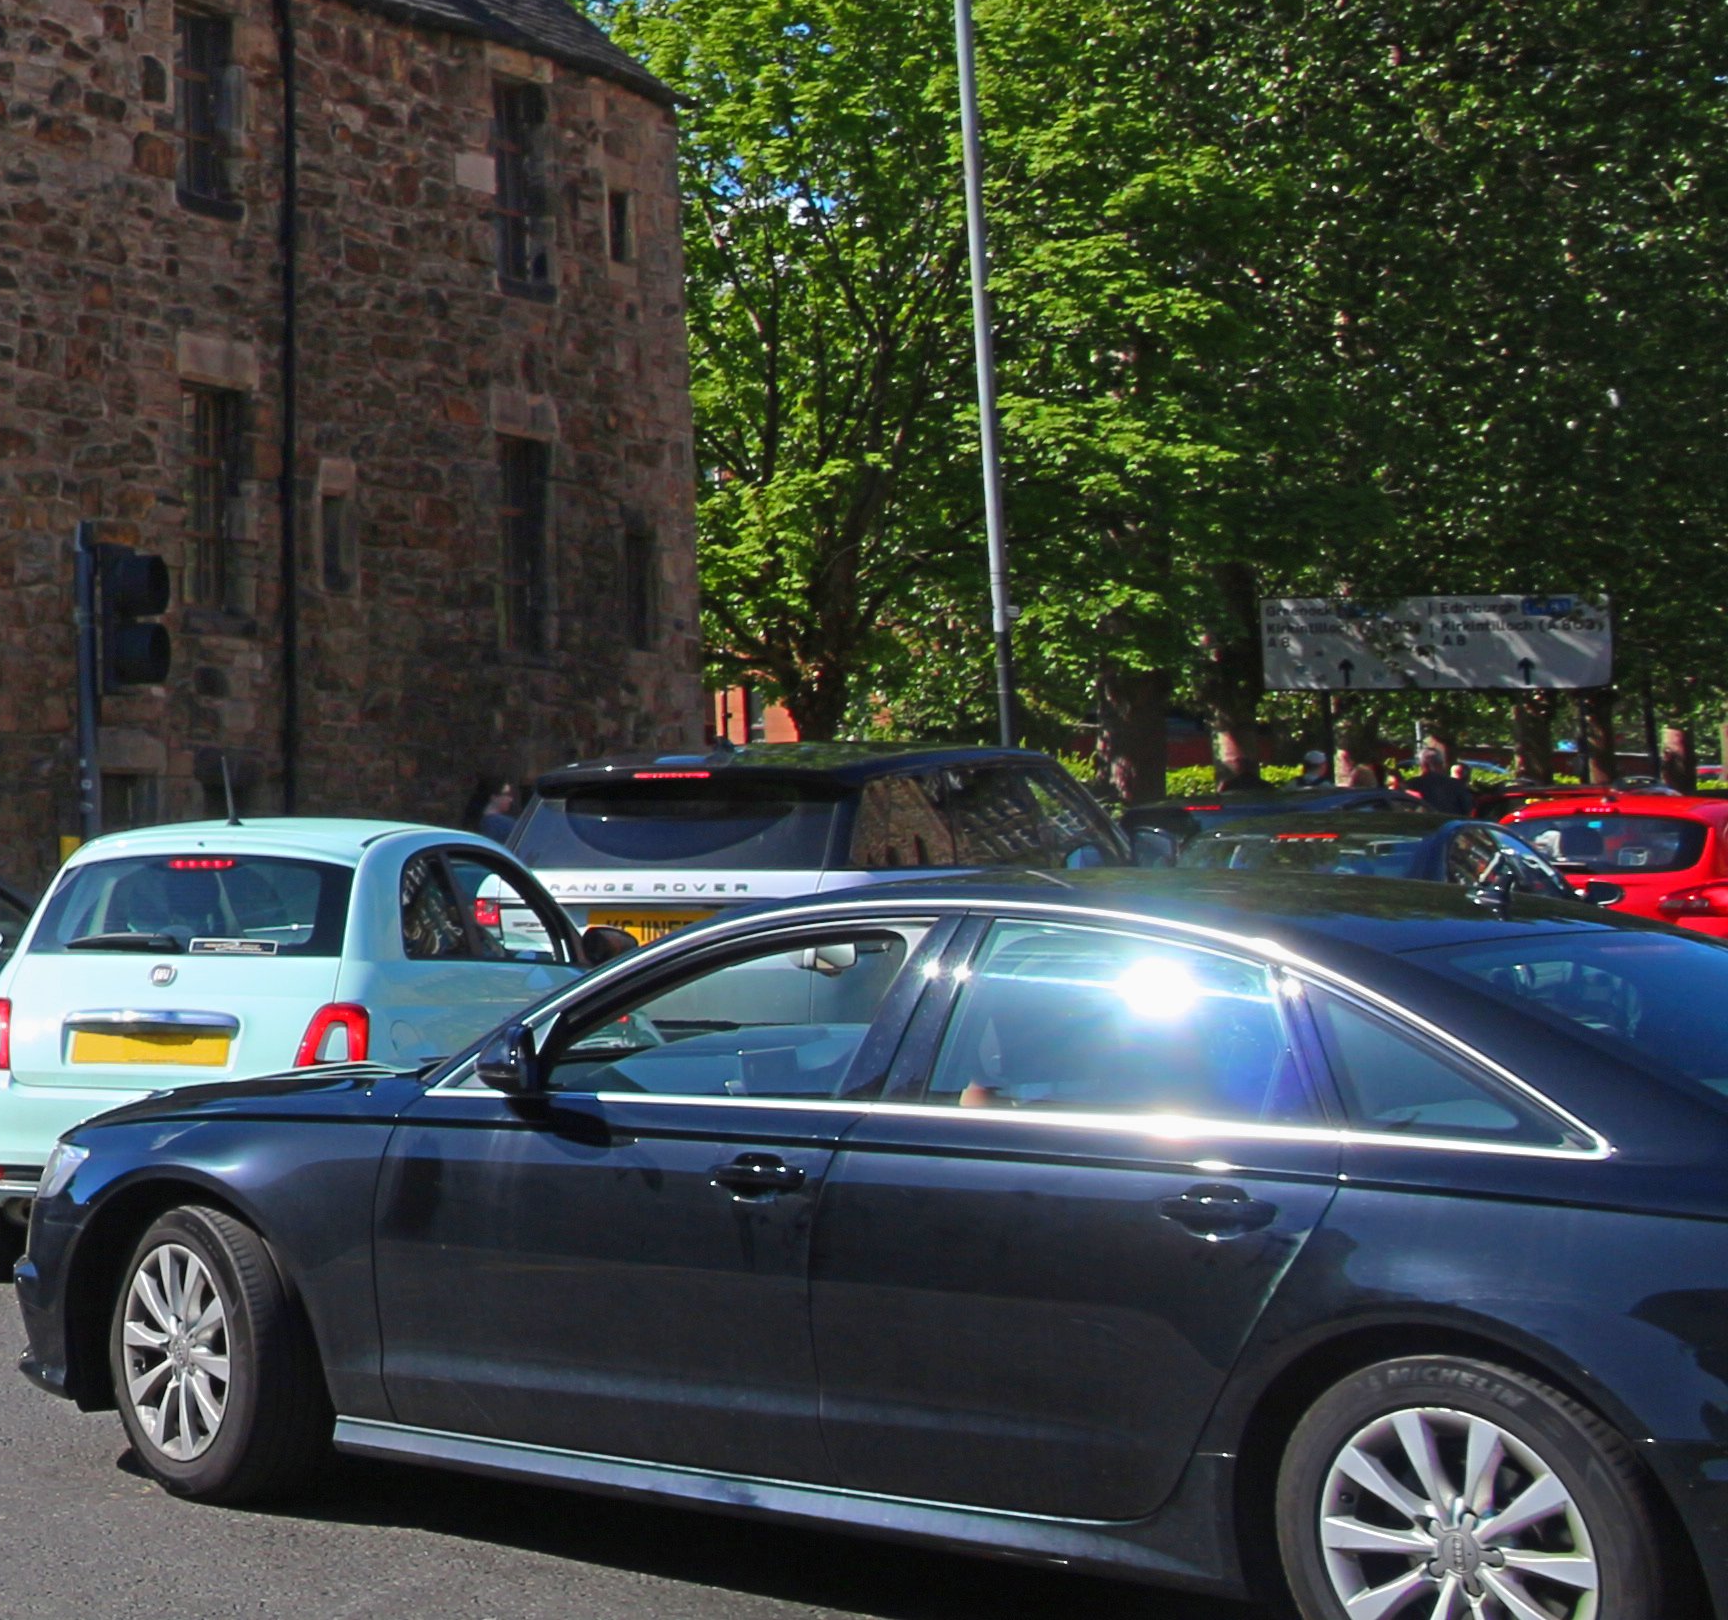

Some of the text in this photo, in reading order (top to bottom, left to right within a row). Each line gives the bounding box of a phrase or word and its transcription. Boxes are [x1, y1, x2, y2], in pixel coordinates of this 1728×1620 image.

[1439, 602, 1518, 615] Edinburgh
[549, 883, 749, 893] RANGE ROVER
